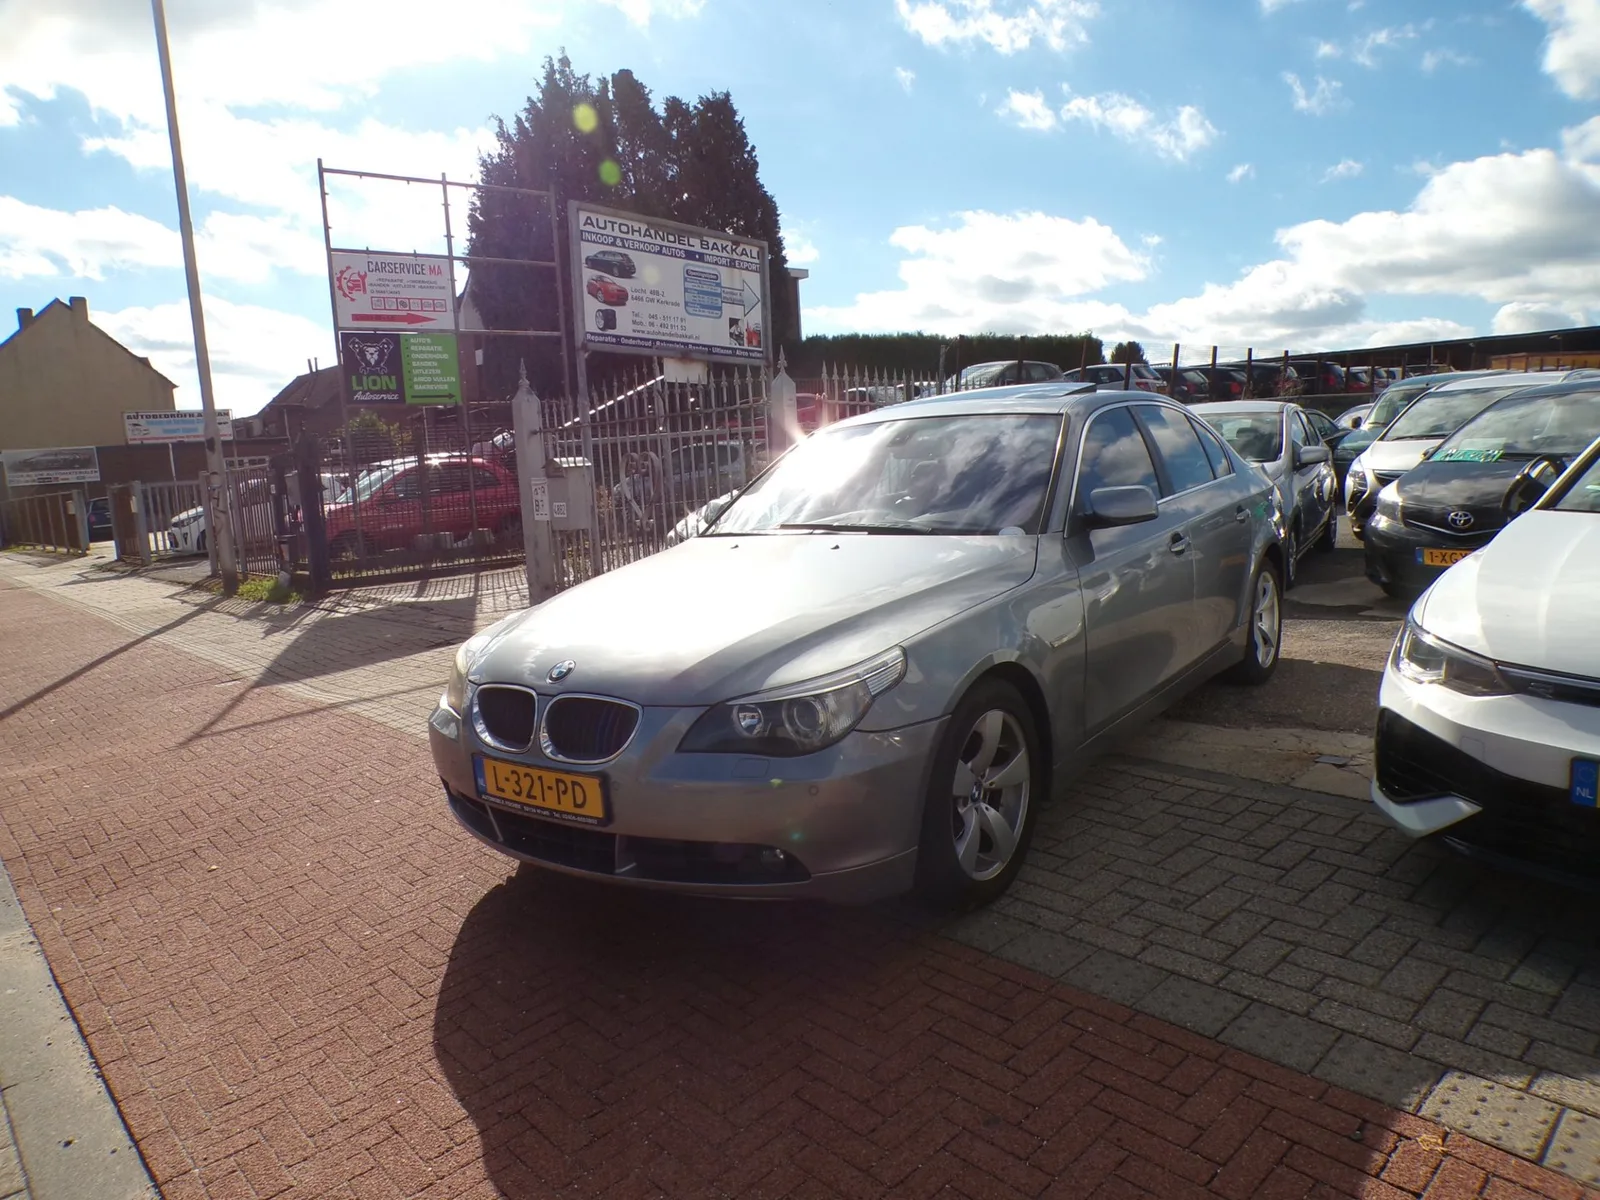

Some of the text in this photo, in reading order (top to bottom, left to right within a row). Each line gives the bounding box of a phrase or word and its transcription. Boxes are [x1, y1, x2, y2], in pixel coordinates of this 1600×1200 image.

[583, 216, 761, 260] AUTOHANDEL BAKKALI
[582, 231, 761, 272] INKOOP & VERKOOP AUTOS IMPORT EXPORT
[367, 260, 443, 276] CARSERVICE MA
[656, 298, 680, 308] Kerkrade
[586, 333, 616, 343] Reparatie
[620, 337, 652, 347] Onderhoud
[632, 328, 700, 340] www.autohandelbakkali.nl
[352, 375, 397, 390] LION
[353, 391, 400, 401] Autoservice
[492, 765, 588, 809] L-321-PD
[1576, 786, 1594, 799] NL
